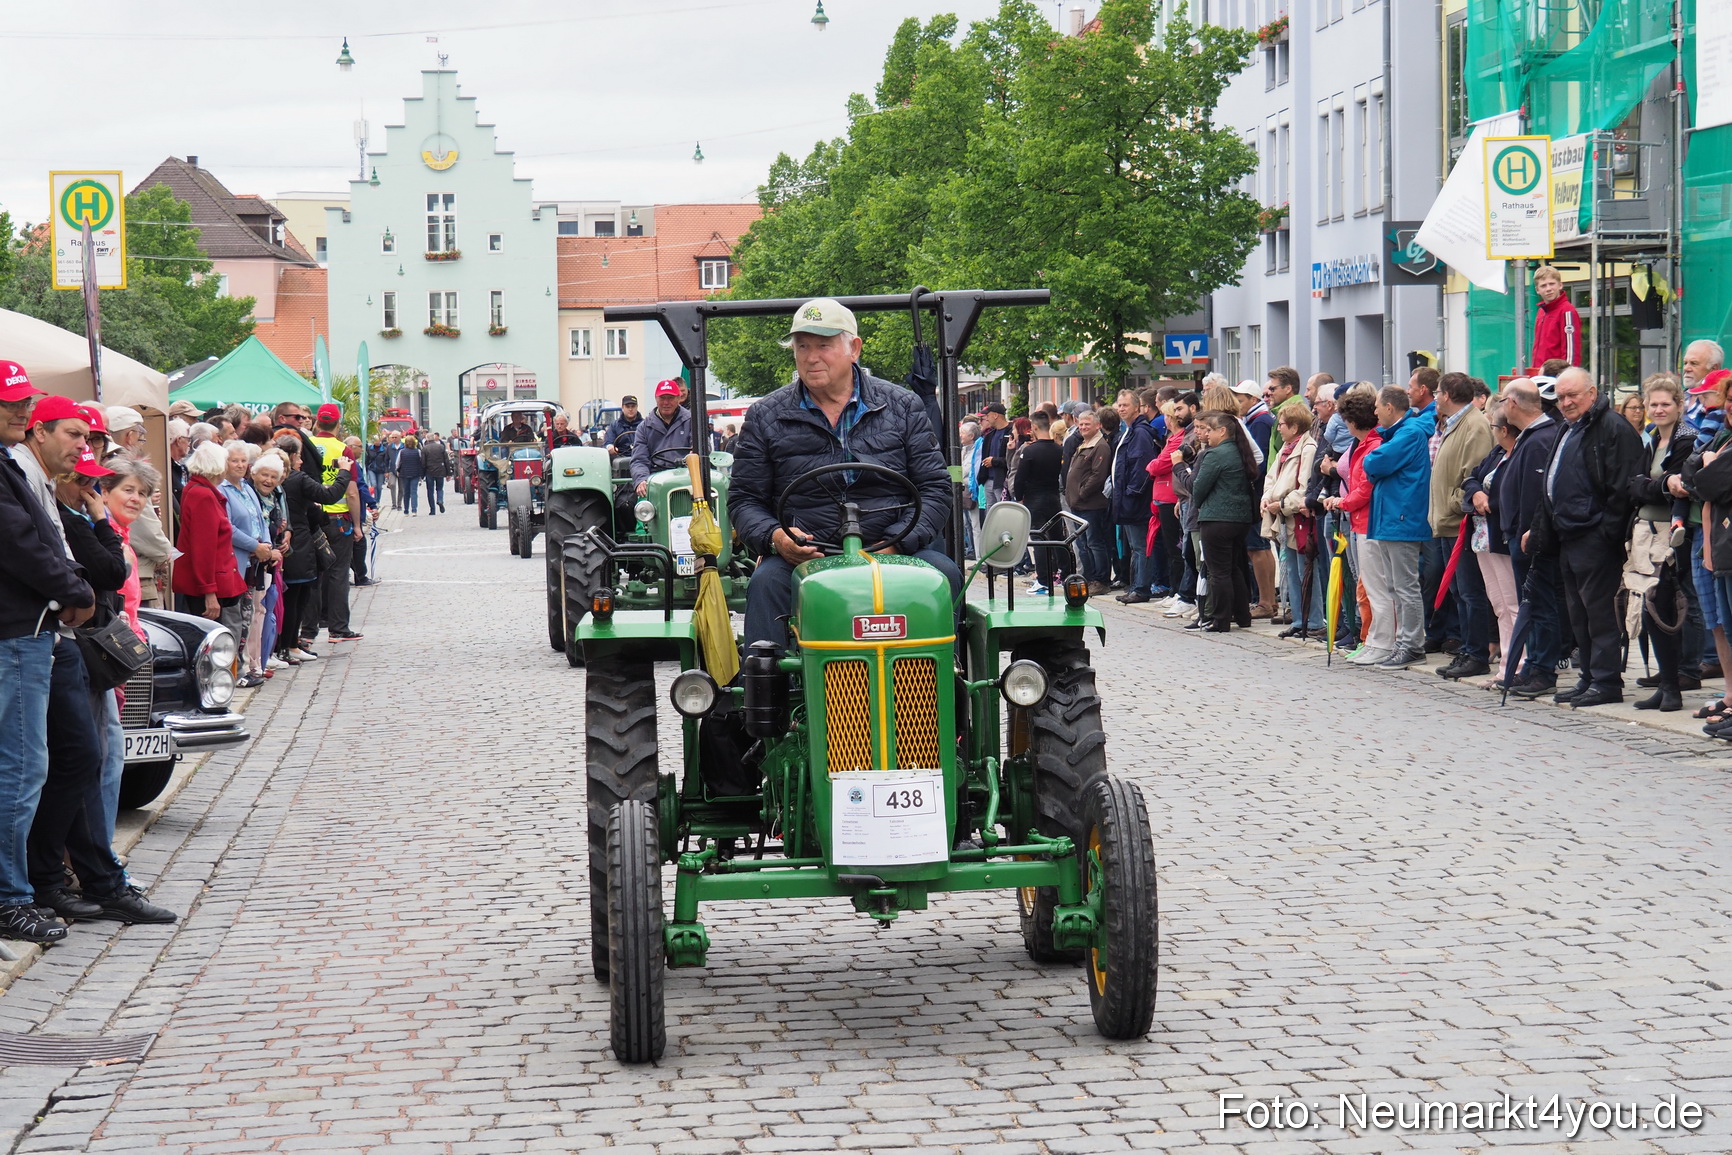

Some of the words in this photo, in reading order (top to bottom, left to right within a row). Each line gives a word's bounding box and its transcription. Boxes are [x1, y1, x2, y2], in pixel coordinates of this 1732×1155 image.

[1507, 156, 1527, 184] H
[75, 191, 99, 220] H
[1322, 254, 1376, 288] Raiffeisenbank
[5, 375, 28, 387] DEKRA
[125, 737, 133, 757] P
[136, 735, 169, 756] 272H
[886, 789, 924, 809] 438
